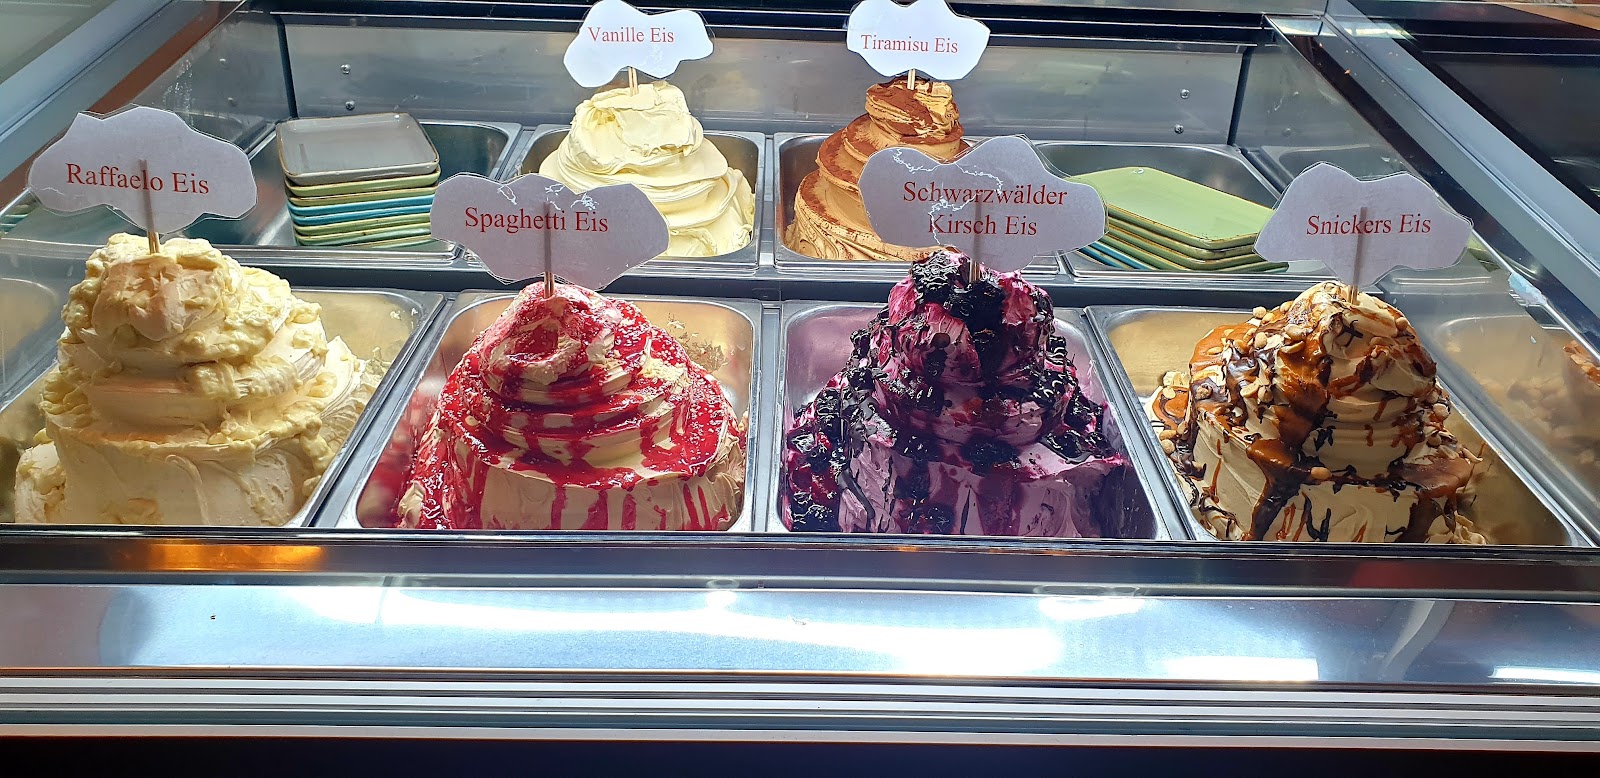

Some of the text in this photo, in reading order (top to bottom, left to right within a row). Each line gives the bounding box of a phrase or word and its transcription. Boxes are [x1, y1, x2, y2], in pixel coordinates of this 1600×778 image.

[588, 26, 674, 43] Vanille Eis
[860, 34, 958, 54] Tiramisu Eis
[66, 162, 210, 194] Raffaelo Eis
[903, 181, 1068, 205] Schwarzwälder
[465, 206, 609, 234] Spaghetti Eis
[928, 213, 1038, 236] Kirsch Eis
[1306, 212, 1432, 236] Snickers Eis
